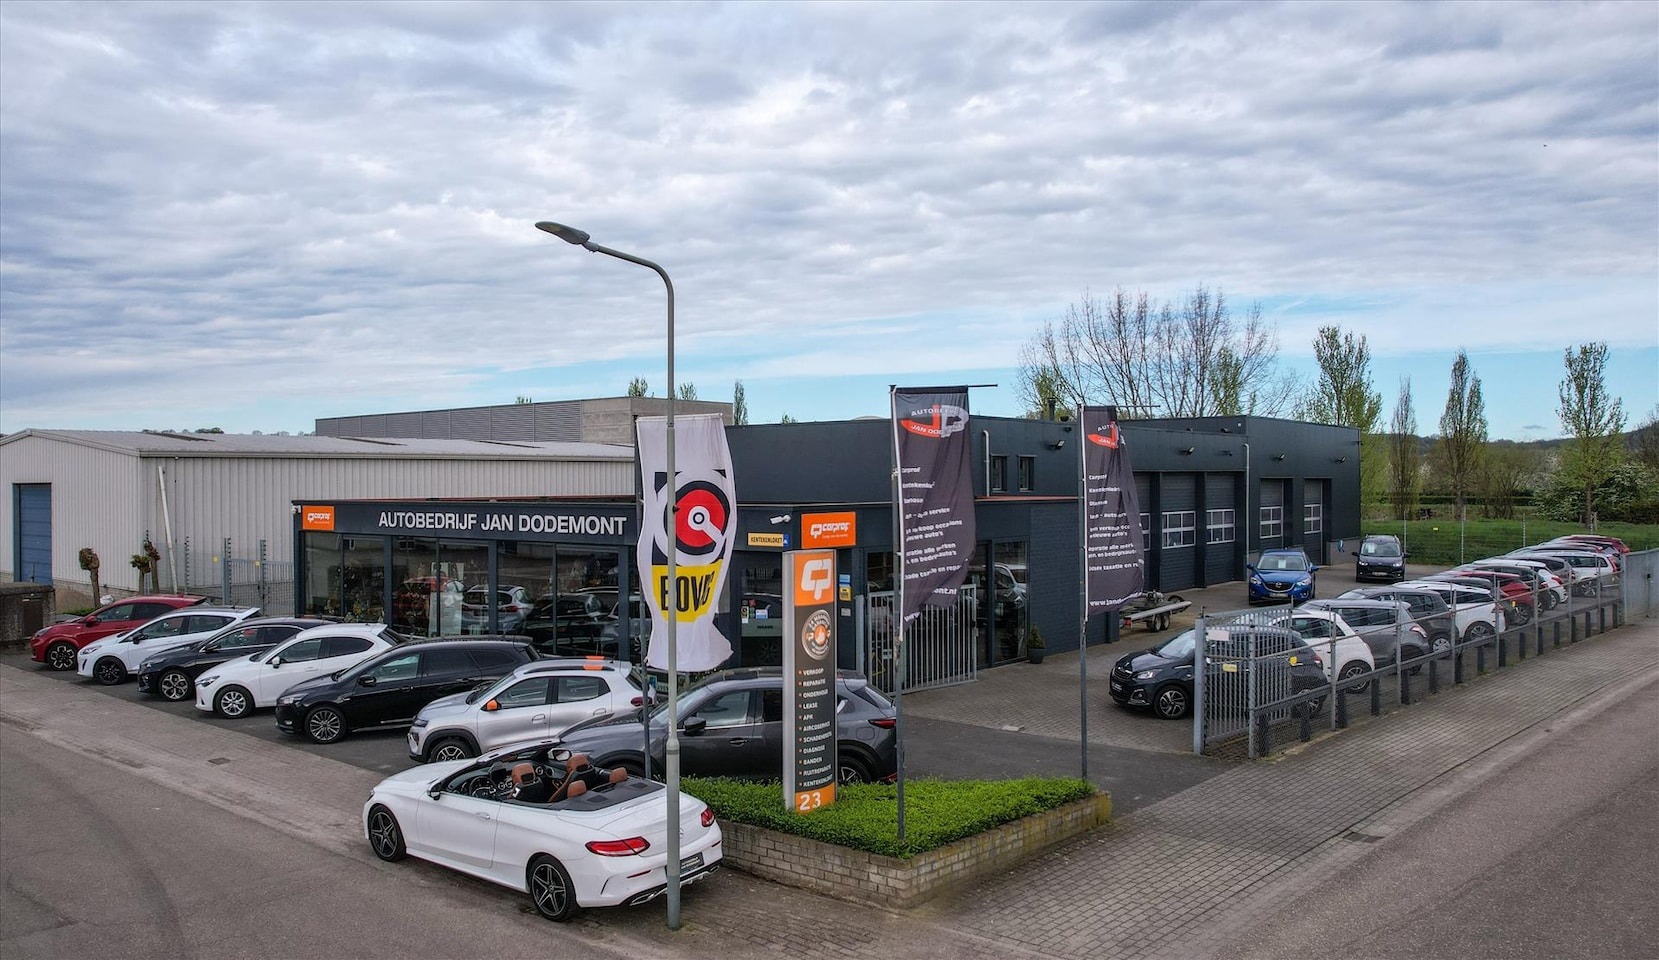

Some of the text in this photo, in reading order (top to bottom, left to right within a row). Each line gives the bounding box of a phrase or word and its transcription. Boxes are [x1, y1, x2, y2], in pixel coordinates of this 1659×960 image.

[911, 424, 926, 433] JAN
[378, 512, 627, 535] AUTOBEDRIJF JAN DODEMONT
[803, 668, 824, 676] VERKOOP
[803, 757, 823, 765] BANDEN
[800, 791, 821, 811] 23
